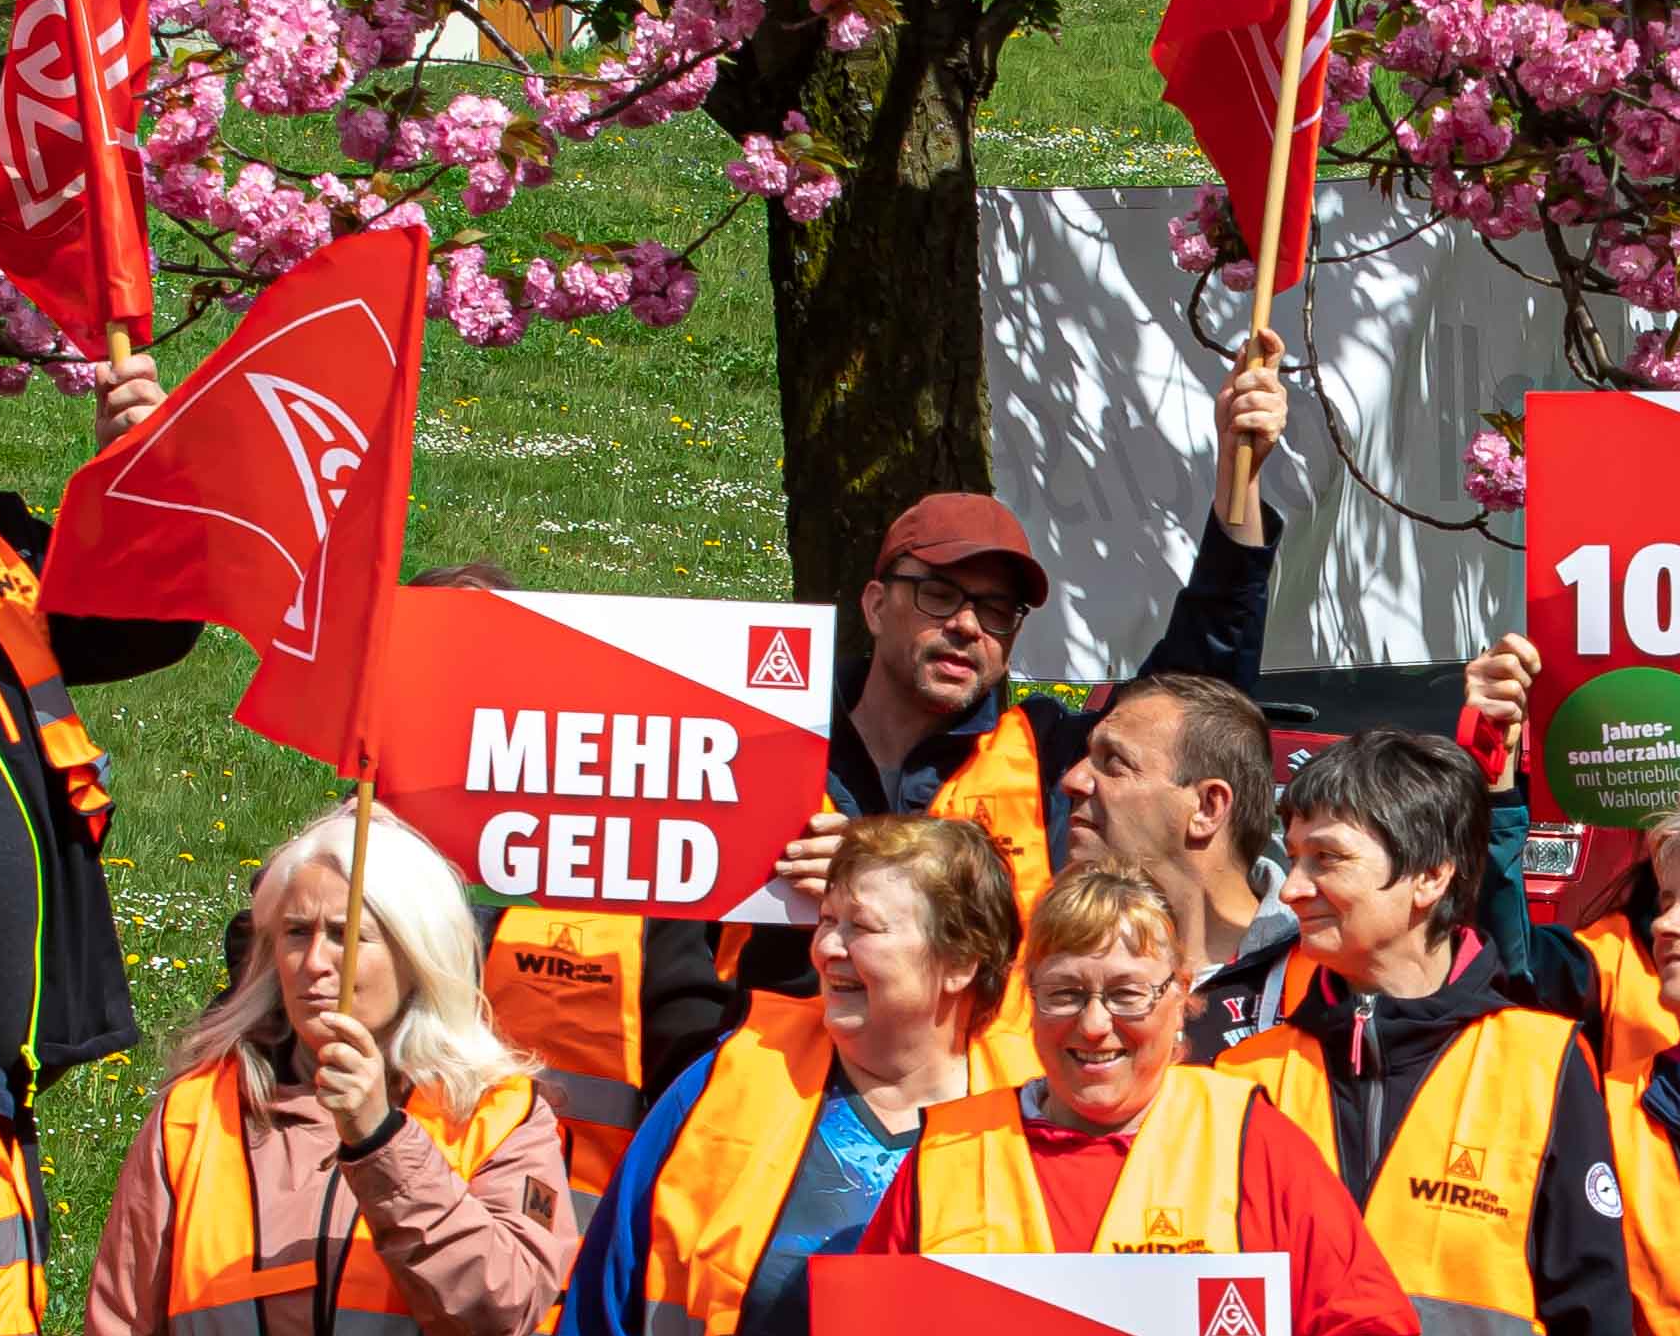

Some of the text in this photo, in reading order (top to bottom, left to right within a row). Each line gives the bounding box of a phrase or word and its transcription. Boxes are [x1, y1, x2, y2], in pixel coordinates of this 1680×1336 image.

[1601, 721, 1672, 744] Jahres-
[465, 707, 739, 803] MEHR
[1575, 771, 1601, 787] mit
[478, 811, 719, 903] GELD
[514, 952, 576, 980] WIR
[1409, 1177, 1471, 1208] WIR
[1472, 1188, 1499, 1203] FÜR
[1471, 1200, 1509, 1218] MEHR
